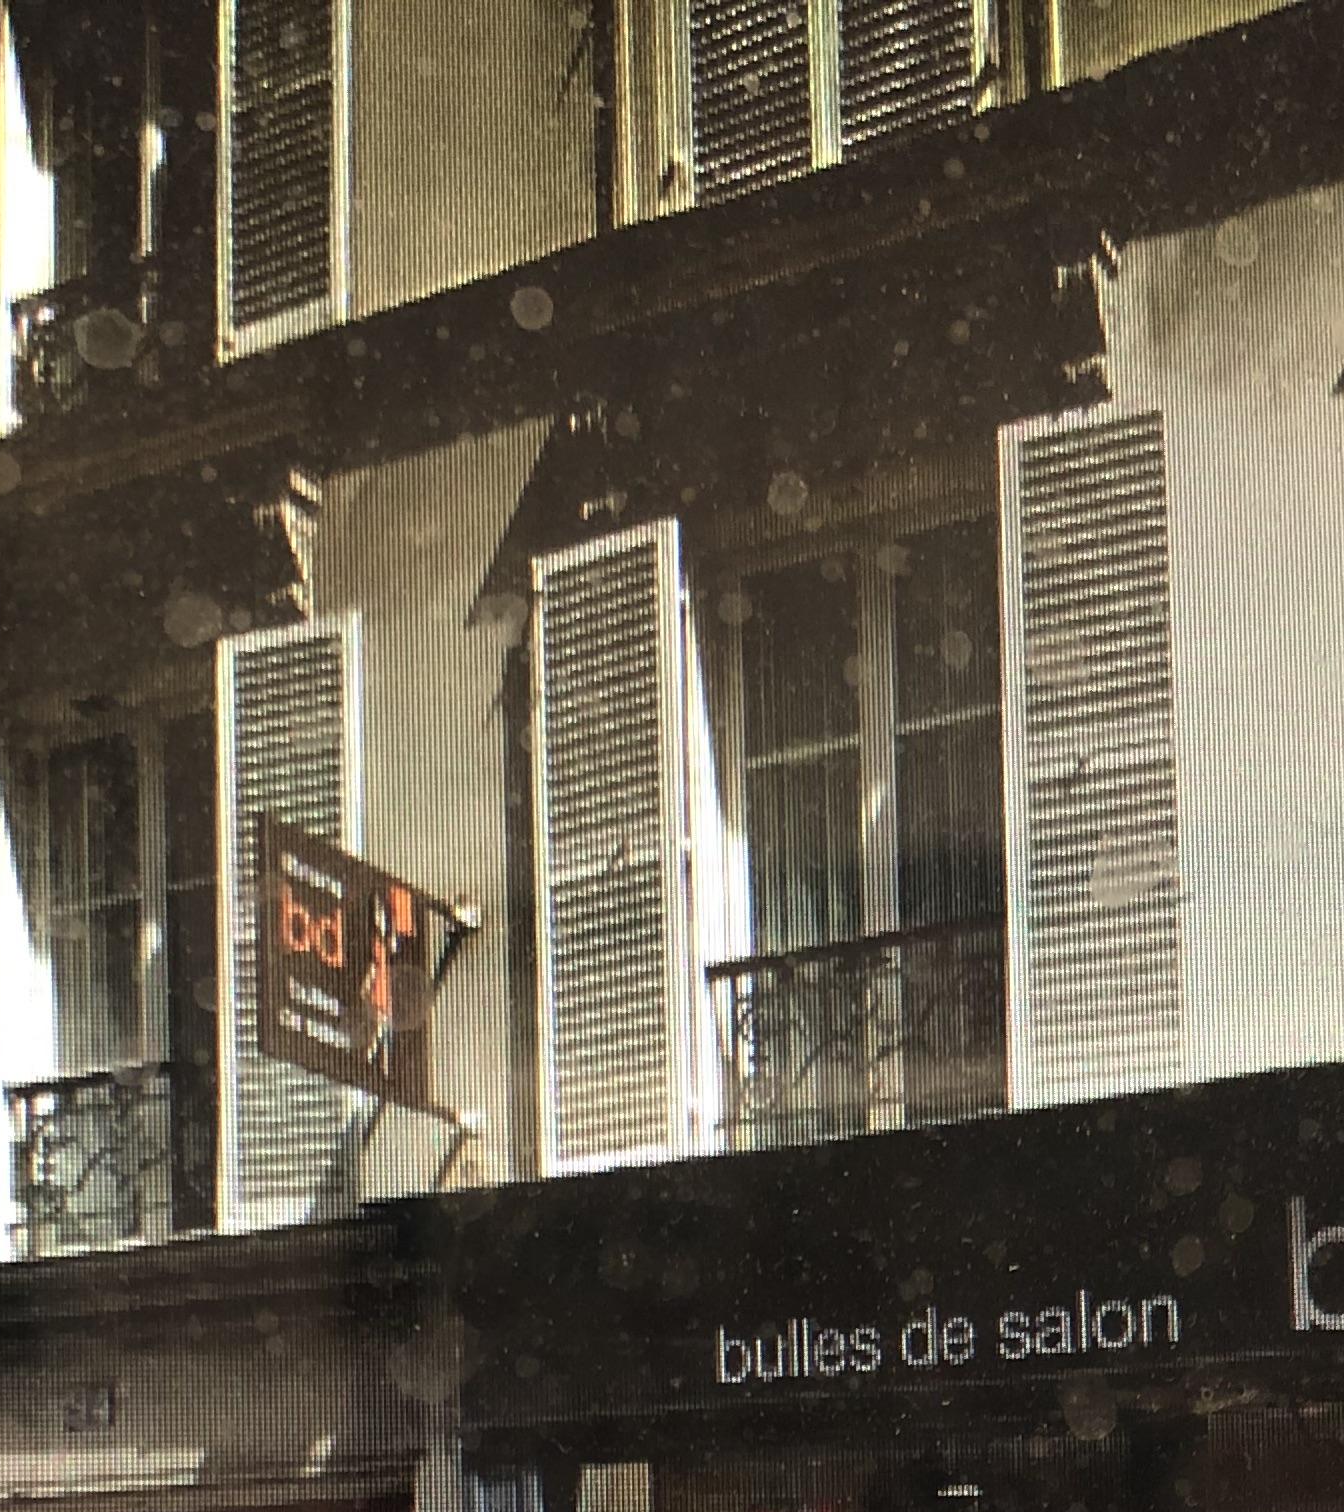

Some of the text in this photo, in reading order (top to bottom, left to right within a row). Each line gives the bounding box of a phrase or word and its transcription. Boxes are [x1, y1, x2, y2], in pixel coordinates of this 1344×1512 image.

[280, 880, 346, 969] bd
[714, 1288, 1182, 1385] bulles de salon
